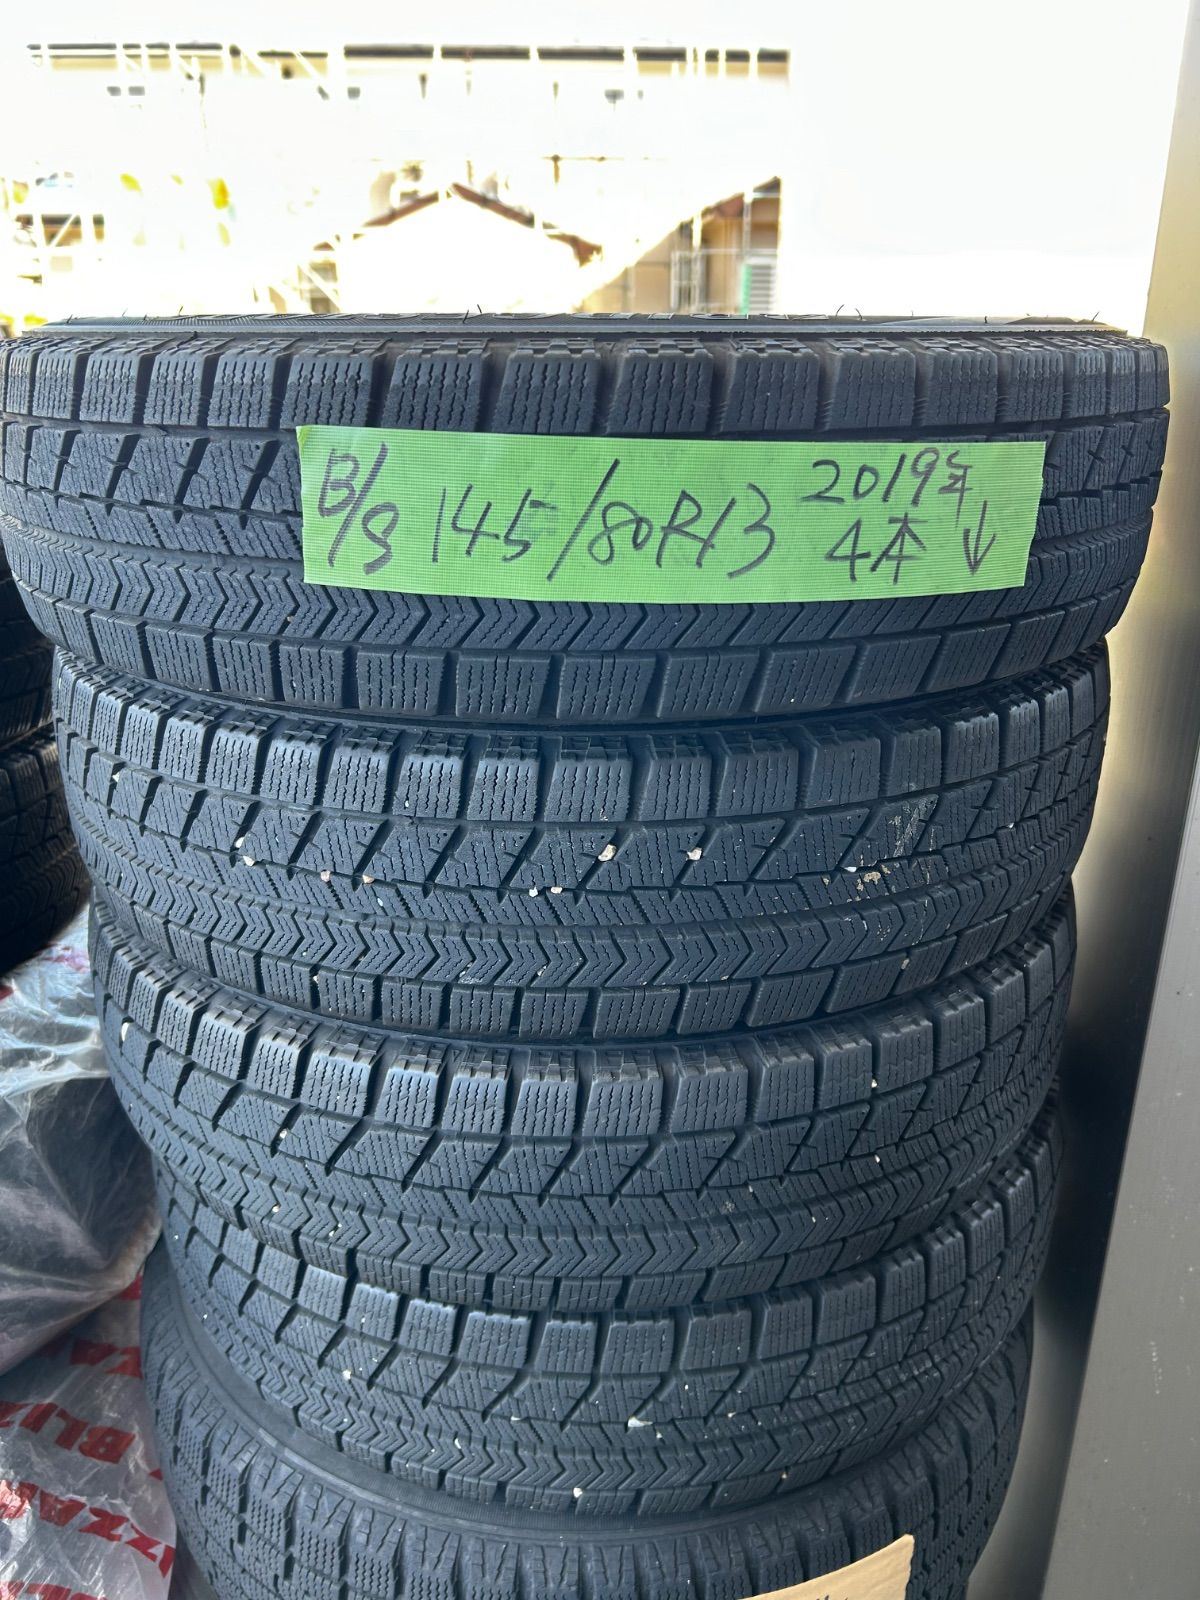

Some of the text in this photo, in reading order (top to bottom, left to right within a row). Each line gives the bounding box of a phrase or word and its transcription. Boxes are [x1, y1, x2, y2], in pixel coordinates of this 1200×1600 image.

[318, 441, 399, 575] B/S
[802, 447, 973, 528] 2019年
[824, 512, 929, 585] 4本
